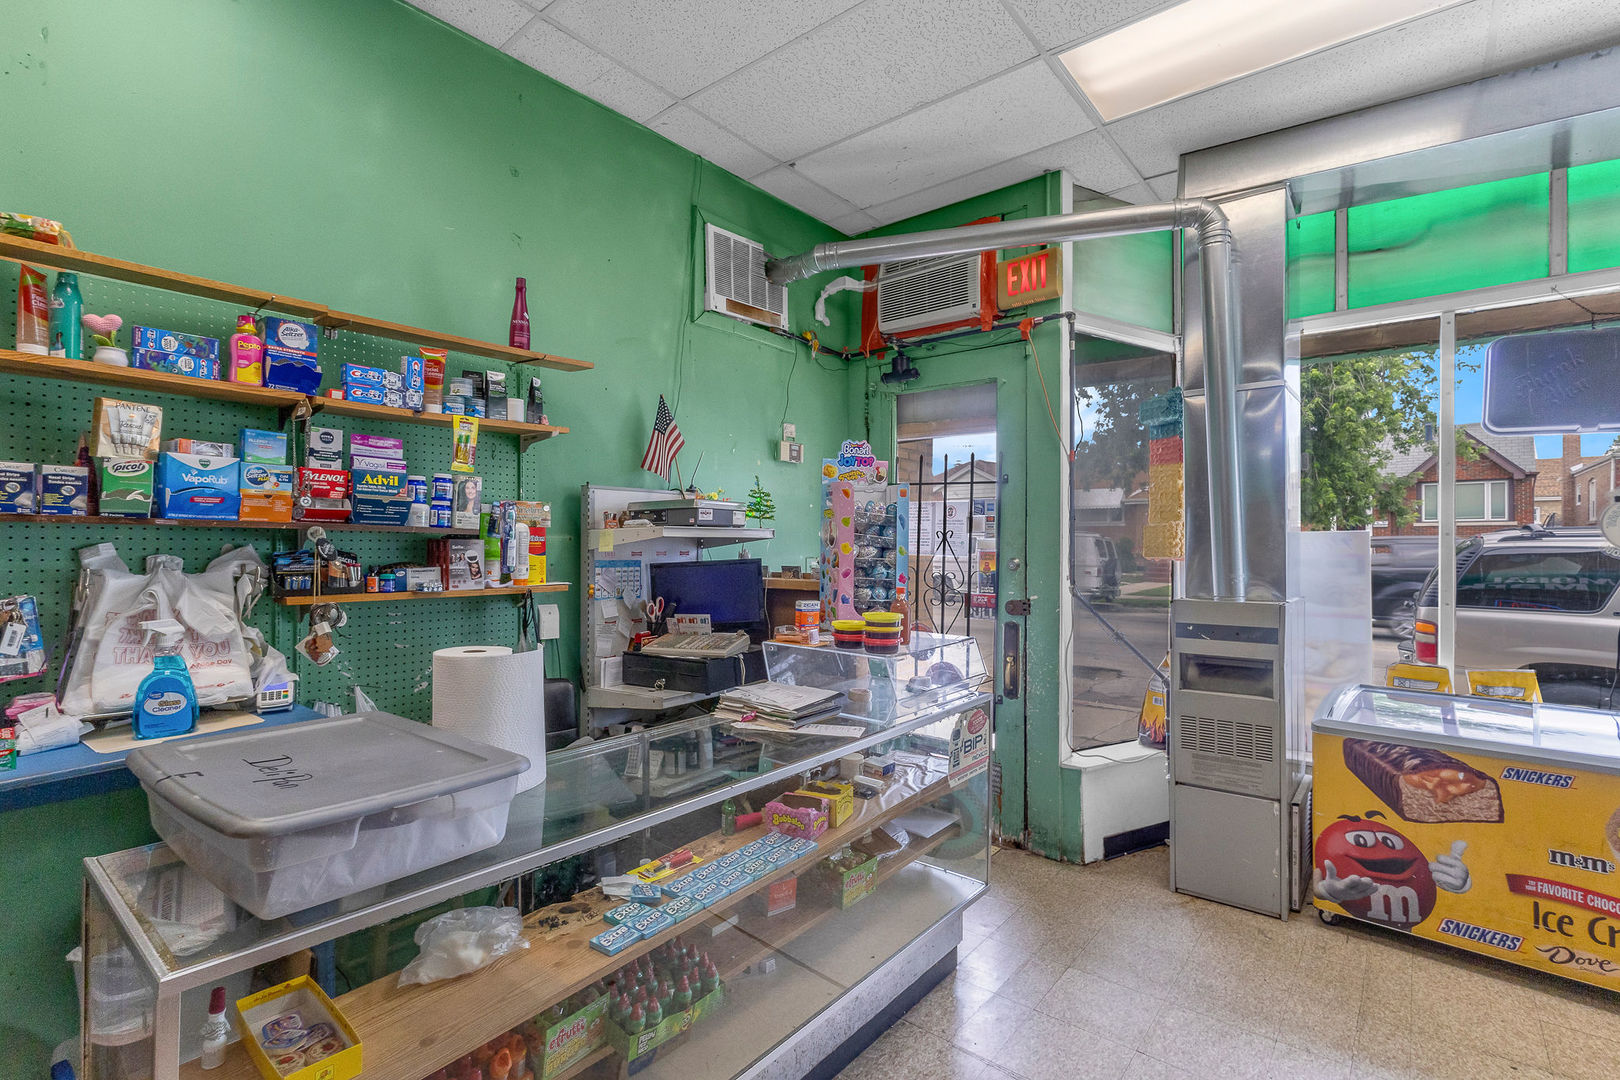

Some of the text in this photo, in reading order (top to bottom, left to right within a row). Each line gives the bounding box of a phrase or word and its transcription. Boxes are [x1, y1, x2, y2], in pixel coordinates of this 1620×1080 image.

[1007, 253, 1049, 297] EXIT
[237, 340, 261, 351] Pepto
[350, 369, 382, 382] Crest
[411, 360, 421, 388] Crest
[351, 388, 383, 401] Crest
[115, 402, 150, 413] PANTENE
[112, 462, 146, 472] picot
[182, 473, 228, 485] VapoRub
[302, 470, 347, 482] TYLENOL
[362, 473, 398, 487] Advil
[152, 705, 181, 713] Cleaner
[1503, 768, 1573, 788] SNICKERS
[743, 842, 762, 857] Extra
[720, 852, 740, 868] Extra
[744, 858, 765, 874] Extra
[696, 863, 718, 880] Extra
[720, 870, 741, 887] Extra
[671, 876, 694, 893] Extra
[694, 883, 717, 901] Extra
[1537, 881, 1585, 904] FAVORITE
[613, 902, 640, 920] Extra
[666, 896, 690, 915] Extra
[635, 911, 662, 931] Extra
[1533, 901, 1575, 938] Ice
[599, 925, 629, 947] Extra
[1440, 919, 1522, 951] SNICKERS
[1538, 946, 1619, 973] Dove
